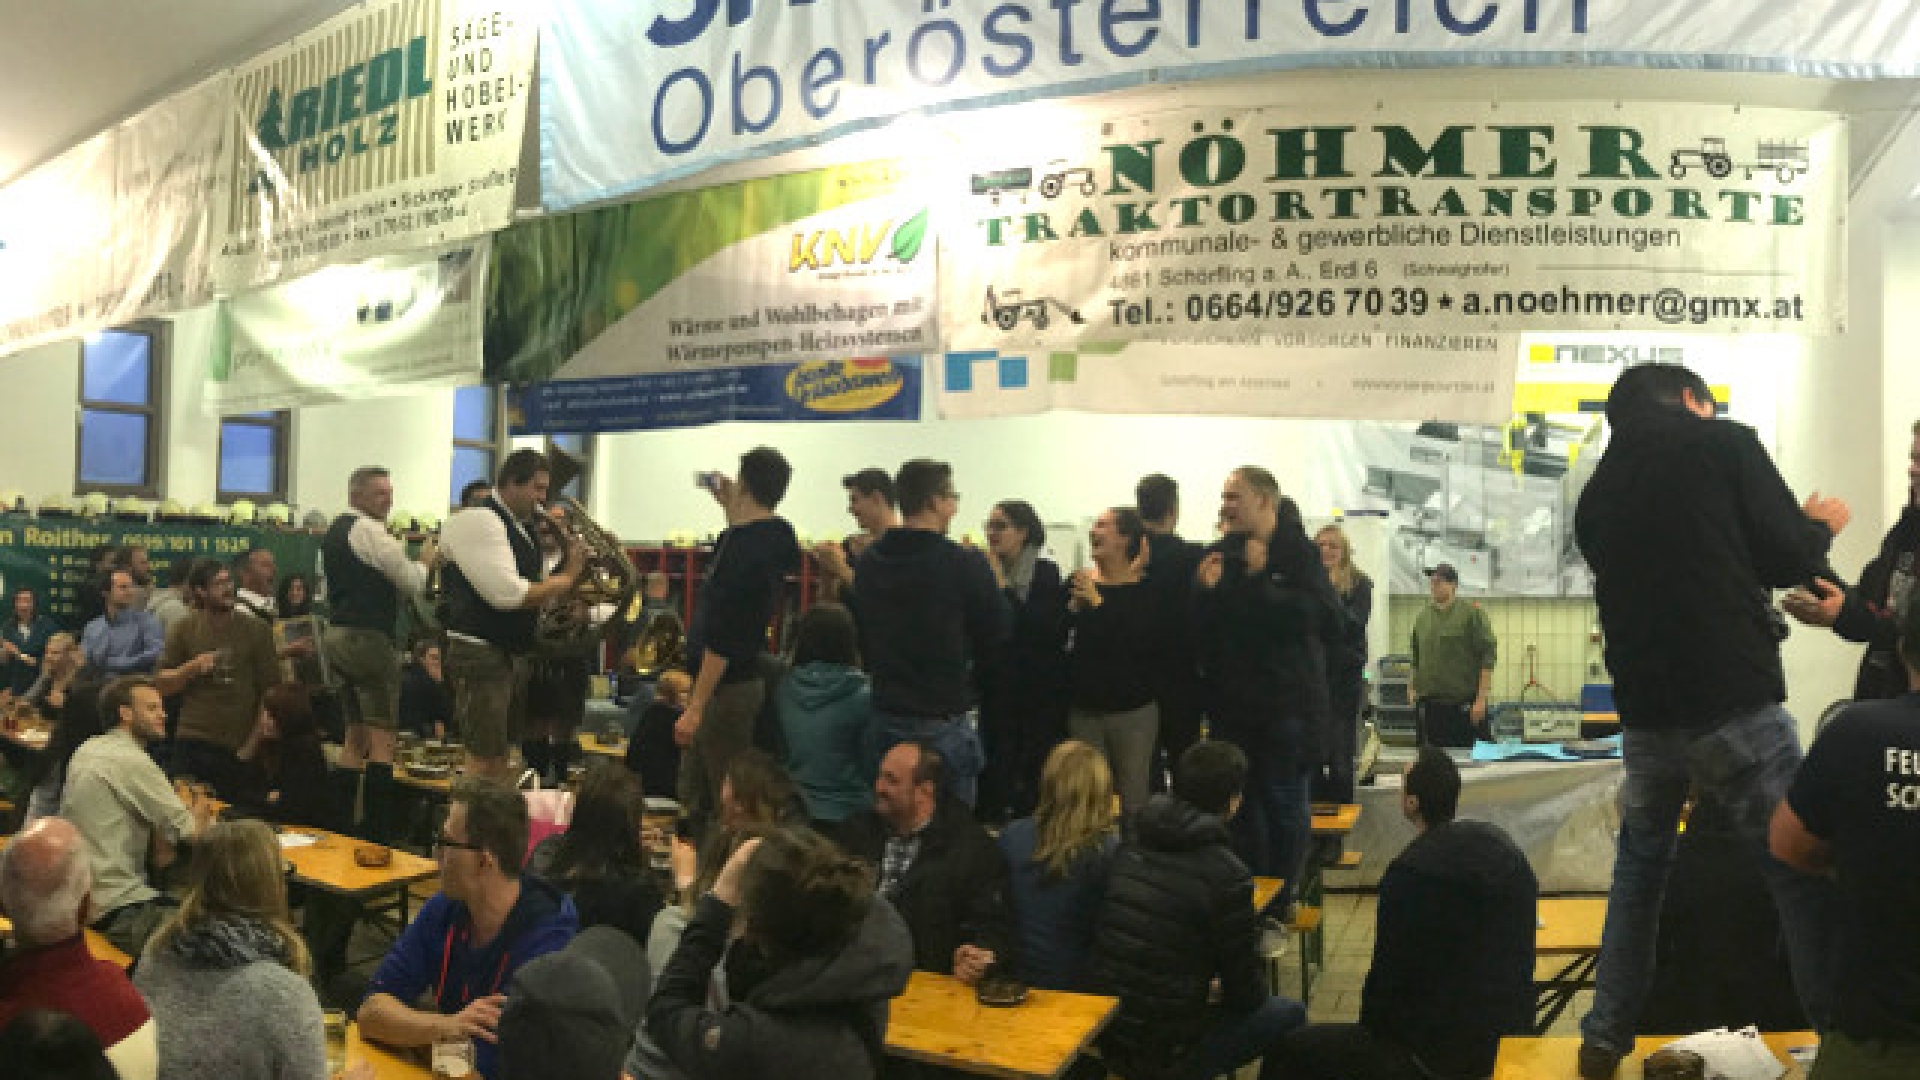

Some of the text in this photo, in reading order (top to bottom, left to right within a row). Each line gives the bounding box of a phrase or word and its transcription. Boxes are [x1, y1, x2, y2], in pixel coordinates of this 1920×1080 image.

[447, 47, 493, 82] UND
[287, 36, 433, 145] RIEDL
[446, 73, 524, 114] HOBEL-
[300, 113, 400, 174] HOLZ
[446, 107, 509, 145] WERK
[1102, 118, 1662, 195] NÖHMER
[977, 186, 1804, 246] TRAKTORTRANSPORTE
[787, 218, 895, 273] KNV
[1110, 222, 1681, 261] kommunale- & gewerbliche Dienstleistungen
[1364, 260, 1378, 278] 6
[728, 308, 760, 328] und
[1108, 285, 1804, 325] Tel.: 0664/926 70 39 a.noehmer@gmx.at
[1385, 333, 1498, 352] FINANZIEREN
